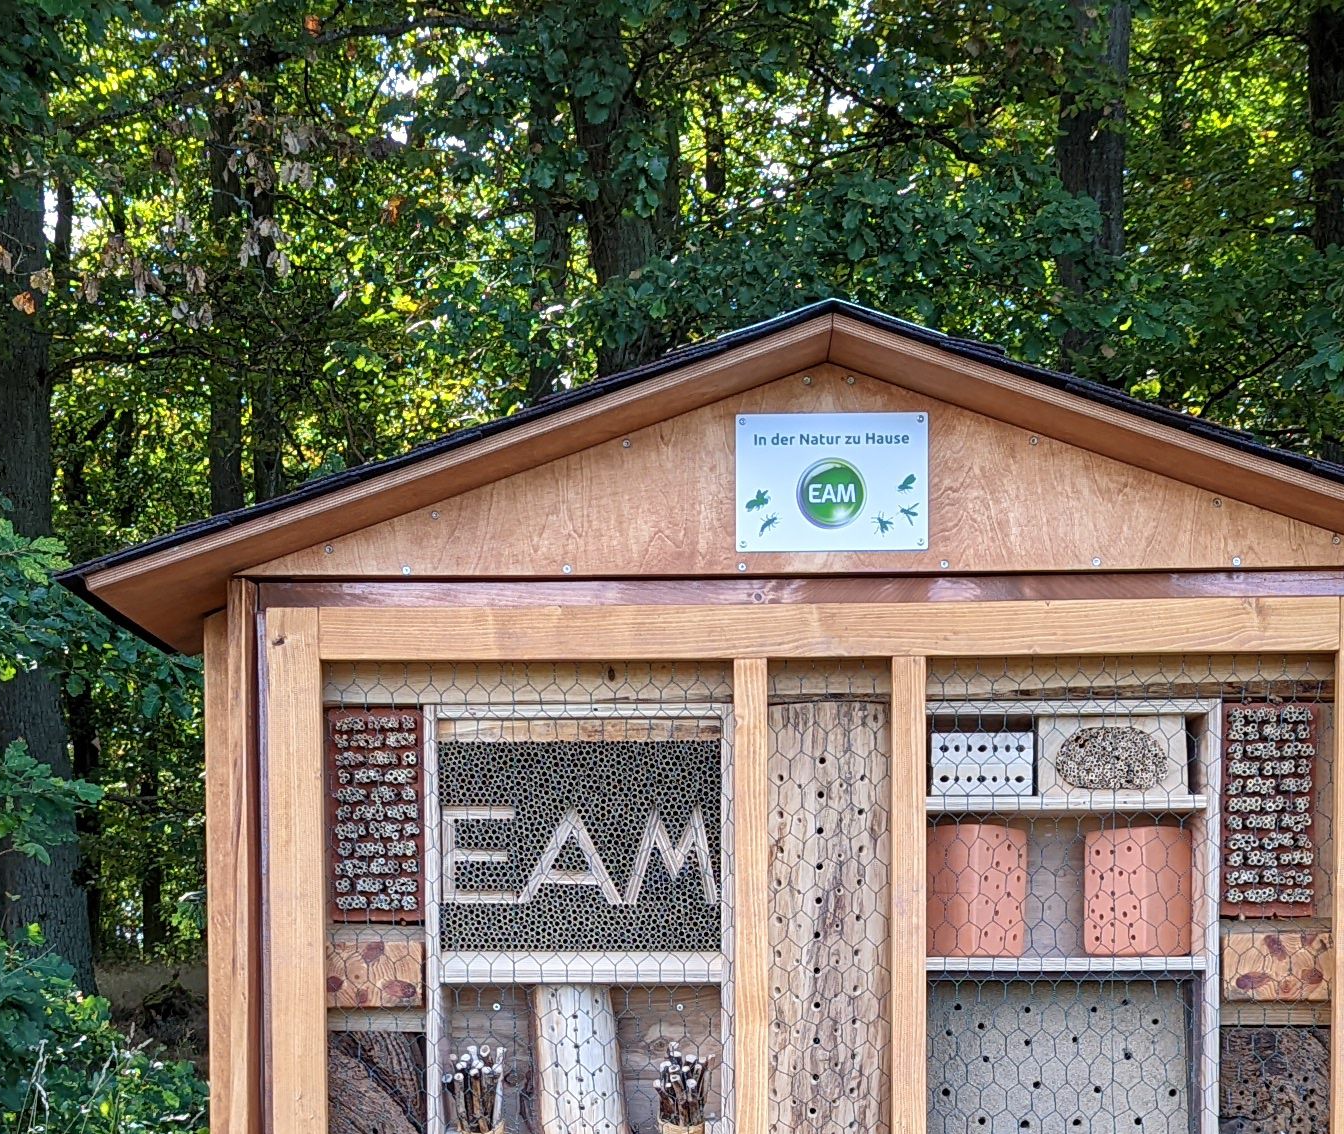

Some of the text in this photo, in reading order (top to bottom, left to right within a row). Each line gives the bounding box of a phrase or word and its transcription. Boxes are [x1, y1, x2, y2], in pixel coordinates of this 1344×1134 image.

[753, 432, 910, 446] In der Natur zu Hause
[808, 483, 856, 504] EAM
[442, 802, 718, 904] EAM
